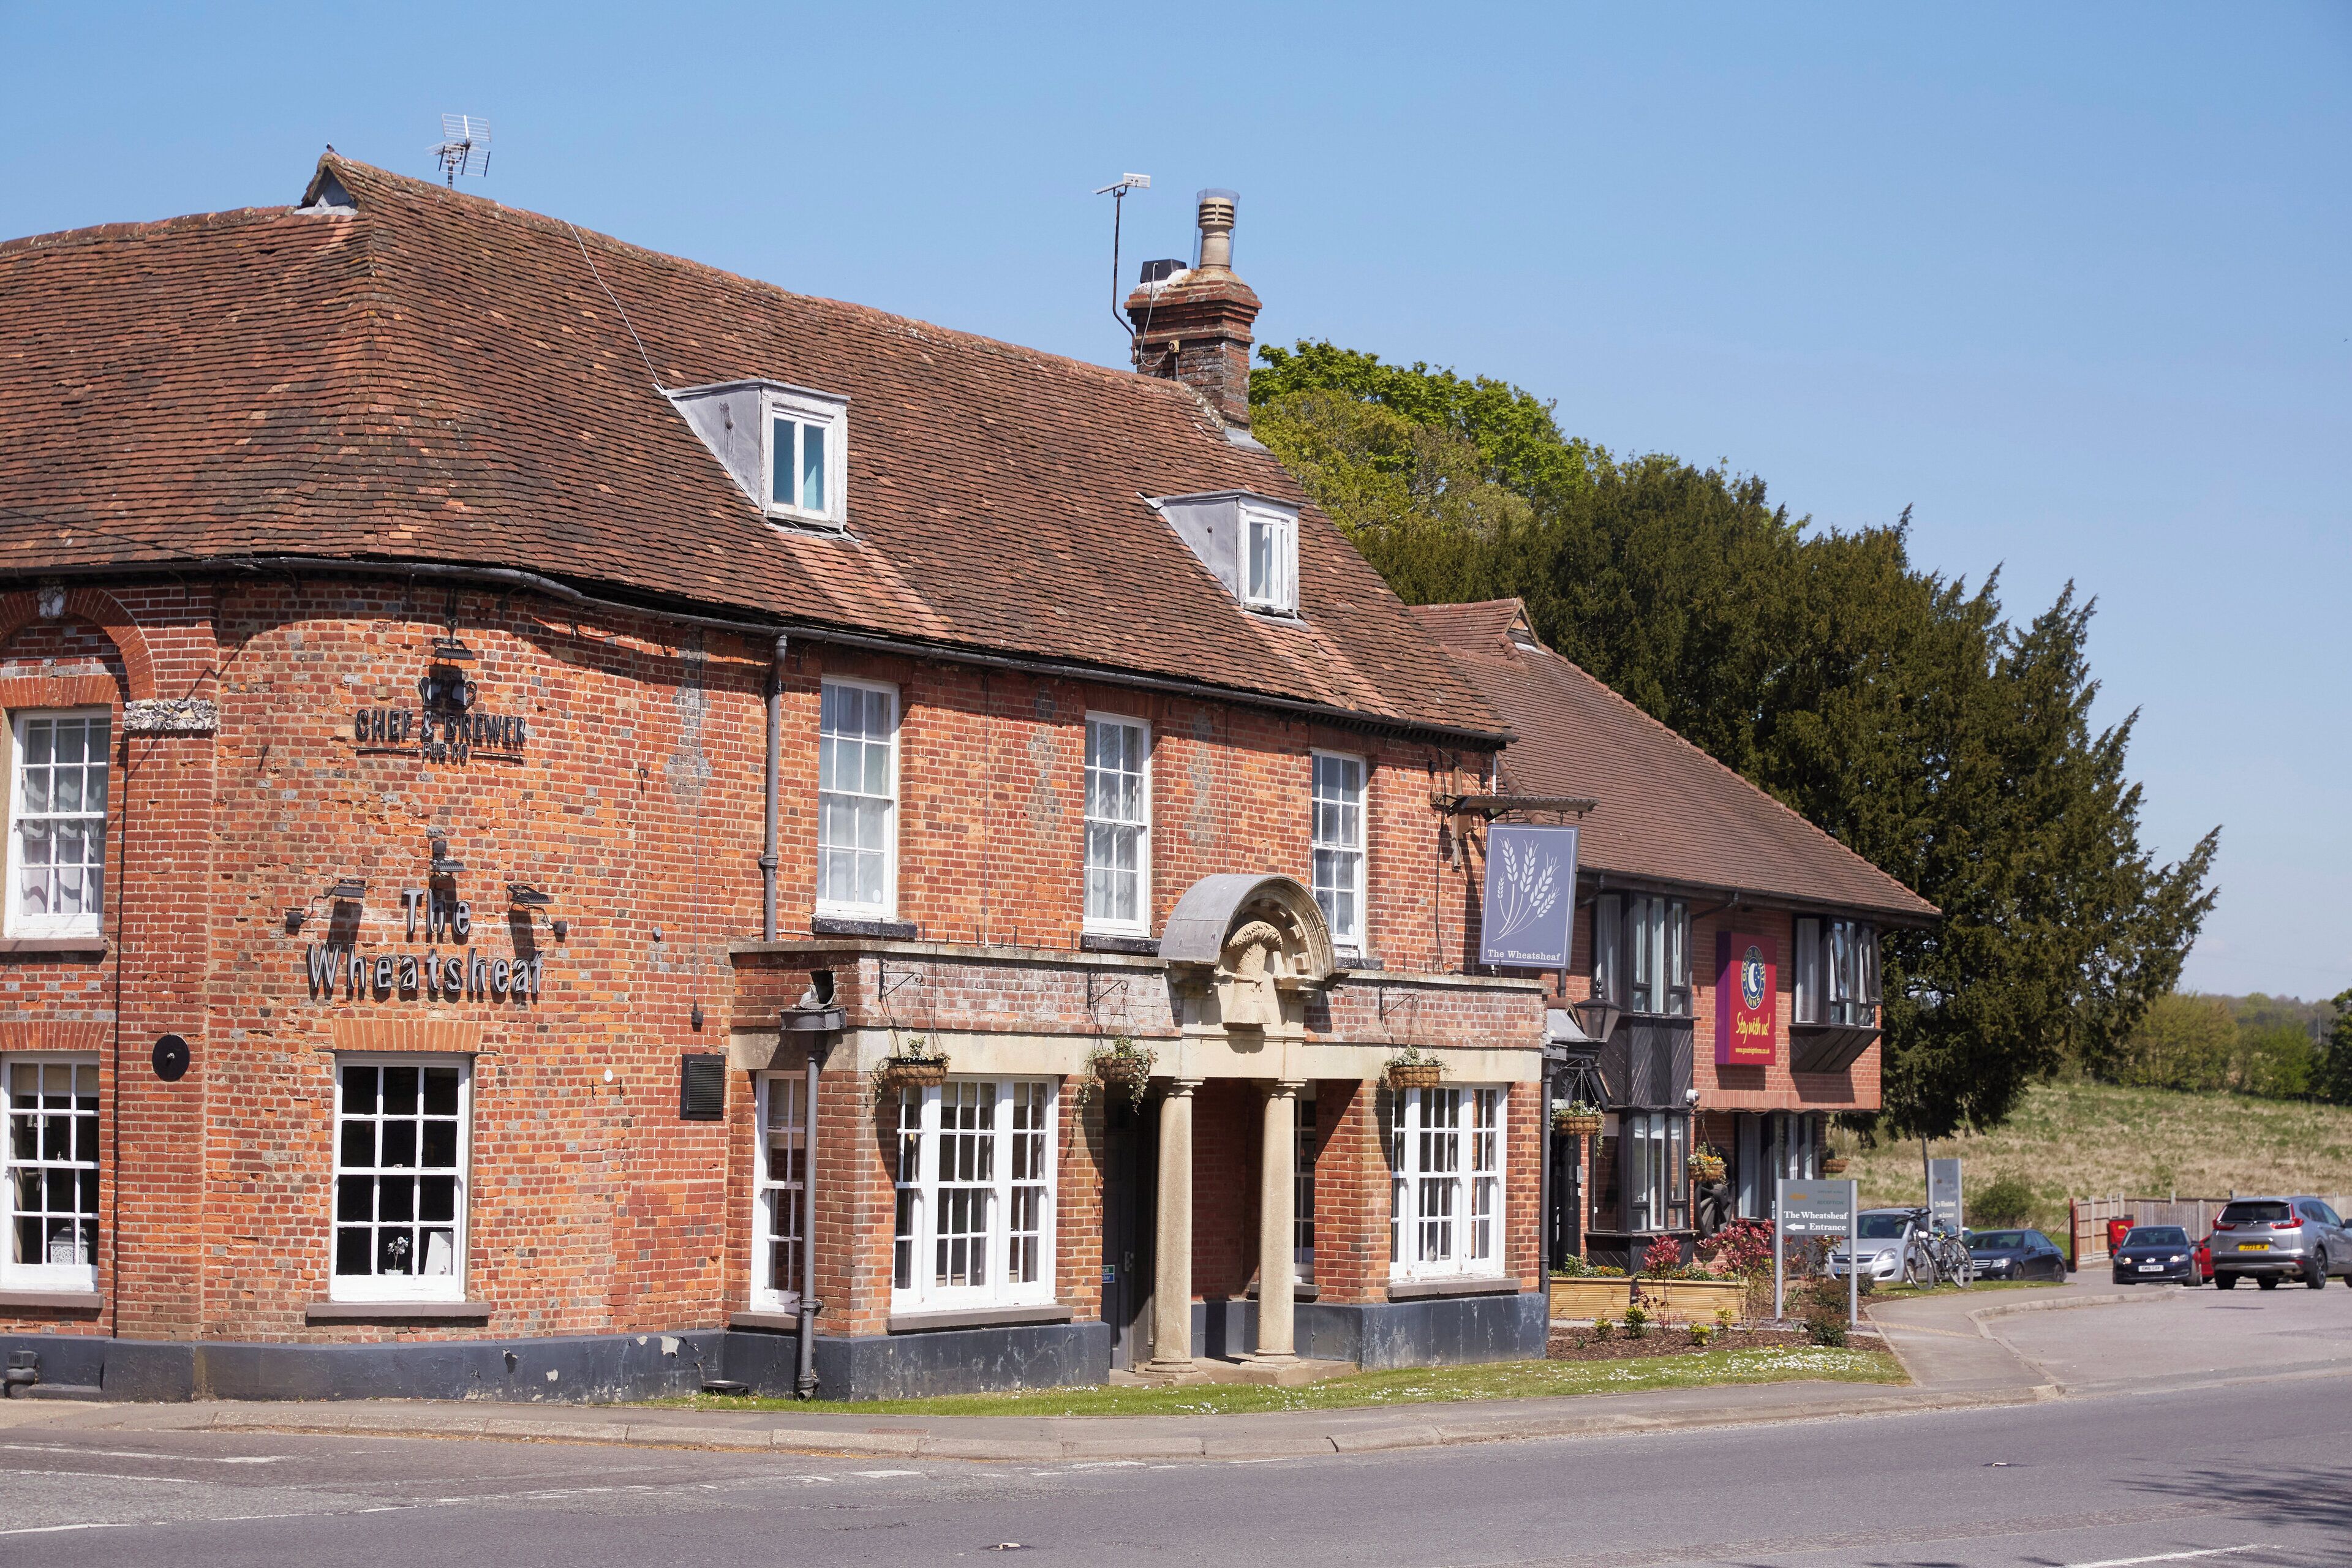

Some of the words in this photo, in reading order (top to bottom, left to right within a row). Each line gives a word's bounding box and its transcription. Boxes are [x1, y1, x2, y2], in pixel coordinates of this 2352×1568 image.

[356, 709, 413, 737] CHEF
[421, 710, 435, 738] &
[444, 712, 526, 743] BREWER
[423, 742, 447, 758] PUB
[452, 743, 469, 759] CO
[402, 888, 471, 935] The
[1487, 949, 1504, 958] The
[1507, 950, 1561, 961] Wheatsheaf
[307, 944, 545, 993] Wheatsheaf
[1746, 993, 1760, 1007] INNS
[1735, 1011, 1748, 1044] Stay
[1749, 1017, 1761, 1036] with
[1809, 1223, 1847, 1231] Entrance
